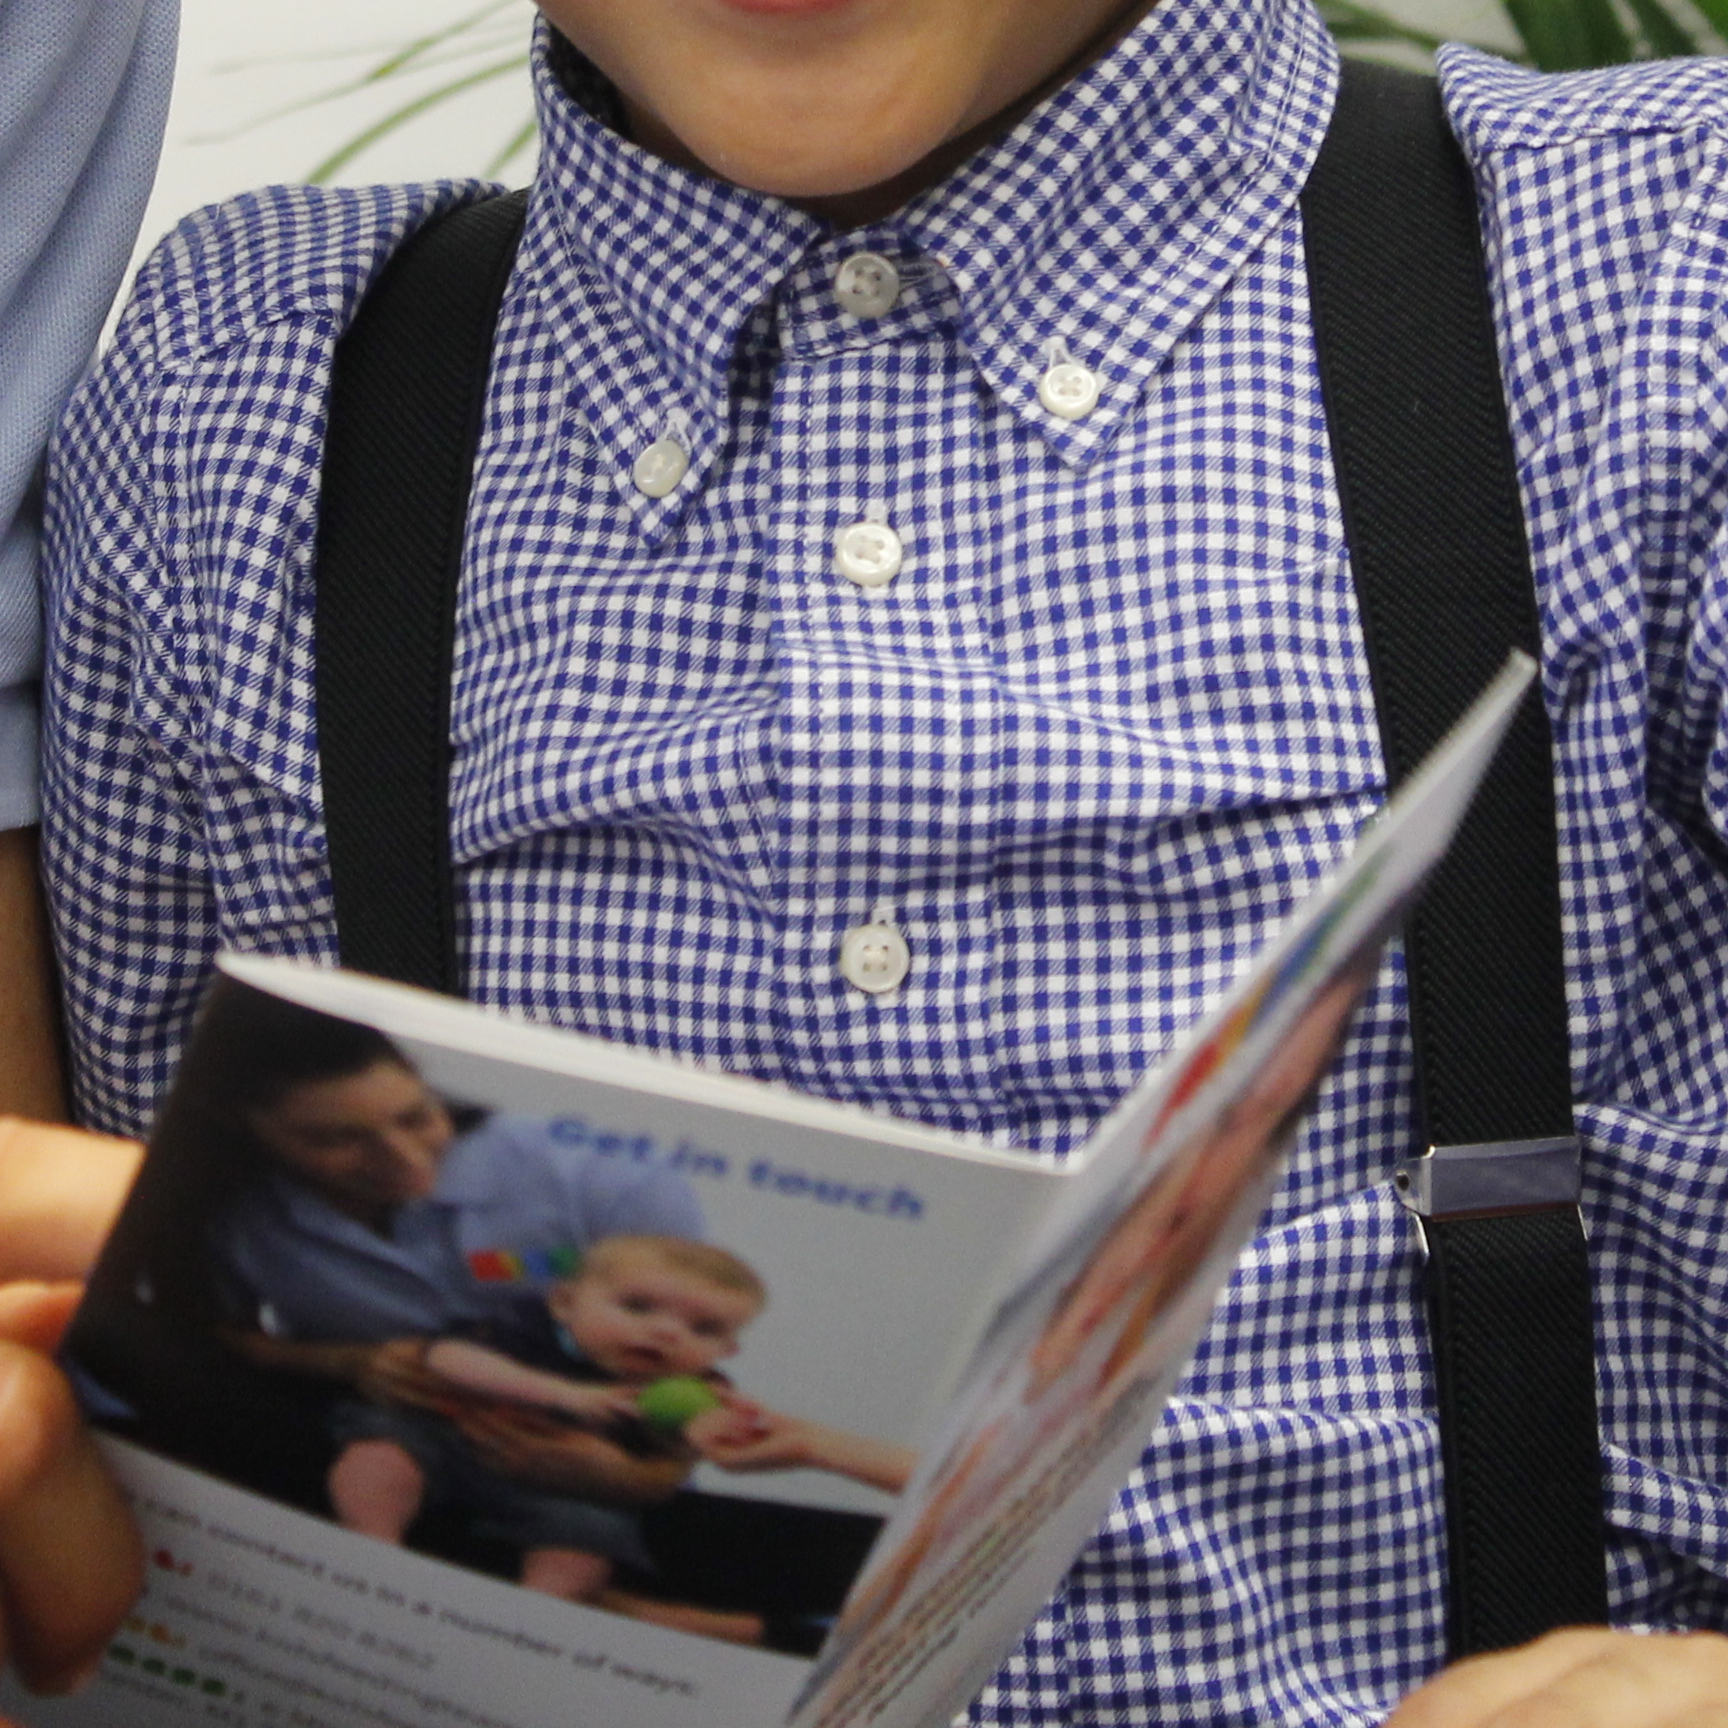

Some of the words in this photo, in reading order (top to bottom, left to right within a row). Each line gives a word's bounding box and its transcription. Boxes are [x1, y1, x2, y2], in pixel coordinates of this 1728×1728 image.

[548, 1114, 653, 1161] Get
[673, 1136, 728, 1177] in
[748, 1157, 924, 1219] touch
